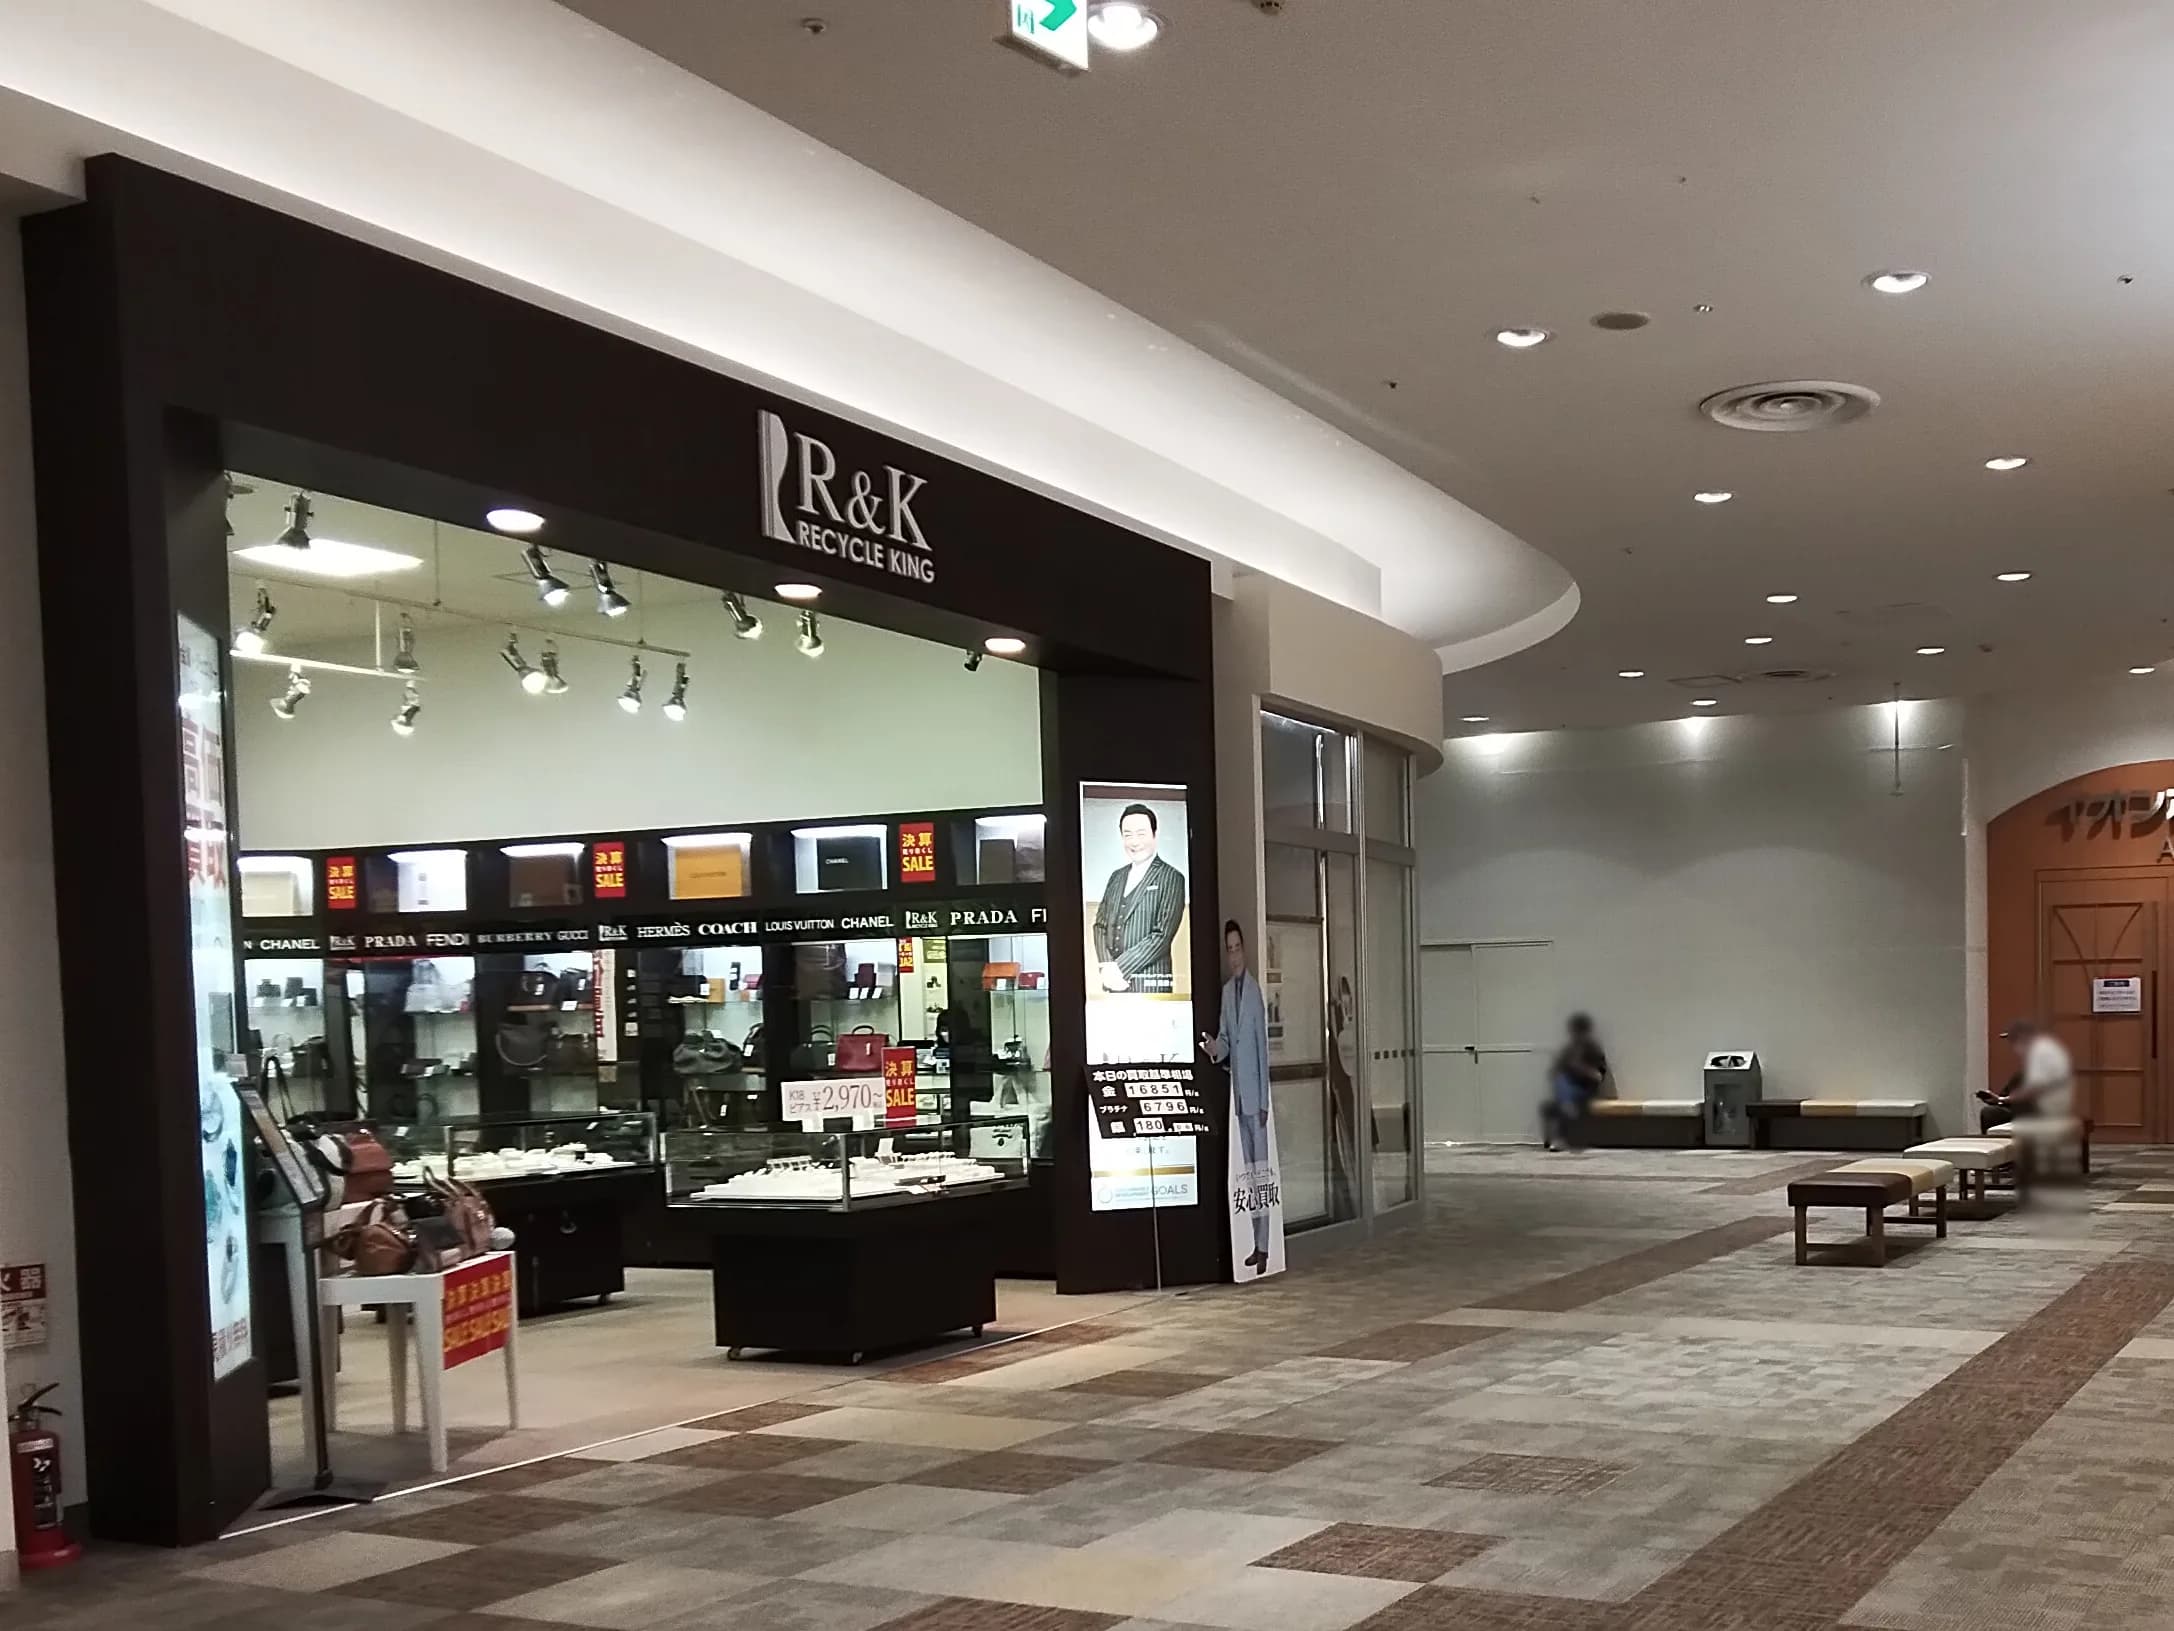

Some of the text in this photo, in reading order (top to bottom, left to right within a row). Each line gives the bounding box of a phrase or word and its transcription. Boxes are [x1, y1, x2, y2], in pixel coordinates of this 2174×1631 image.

[793, 431, 933, 551] R&K
[797, 520, 936, 583] RECYCLE KING
[902, 832, 932, 848] 決算
[902, 855, 934, 872] SALE
[595, 872, 624, 888] SALE
[328, 885, 355, 899] SALE
[260, 938, 321, 950] CHANEL
[364, 935, 417, 949] PRADA
[426, 933, 470, 946] FENDI
[477, 931, 551, 944] BURBERRY
[557, 929, 589, 941] GUCCI
[637, 921, 691, 939] HERMÈS
[698, 921, 758, 936] COACH
[766, 920, 793, 932] LOUIS
[794, 918, 834, 930] VUITTON
[841, 916, 896, 929] CHANEL
[951, 908, 1018, 926] PRADA
[885, 1060, 914, 1077] 決算
[886, 1088, 915, 1107] SALE
[1101, 1085, 1117, 1098] 金
[1129, 1083, 1180, 1095] 16851
[1099, 1104, 1129, 1114] プラチナ
[1143, 1101, 1186, 1112] 6796
[1137, 1119, 1163, 1131] 180
[1233, 1182, 1280, 1215] 安心買取
